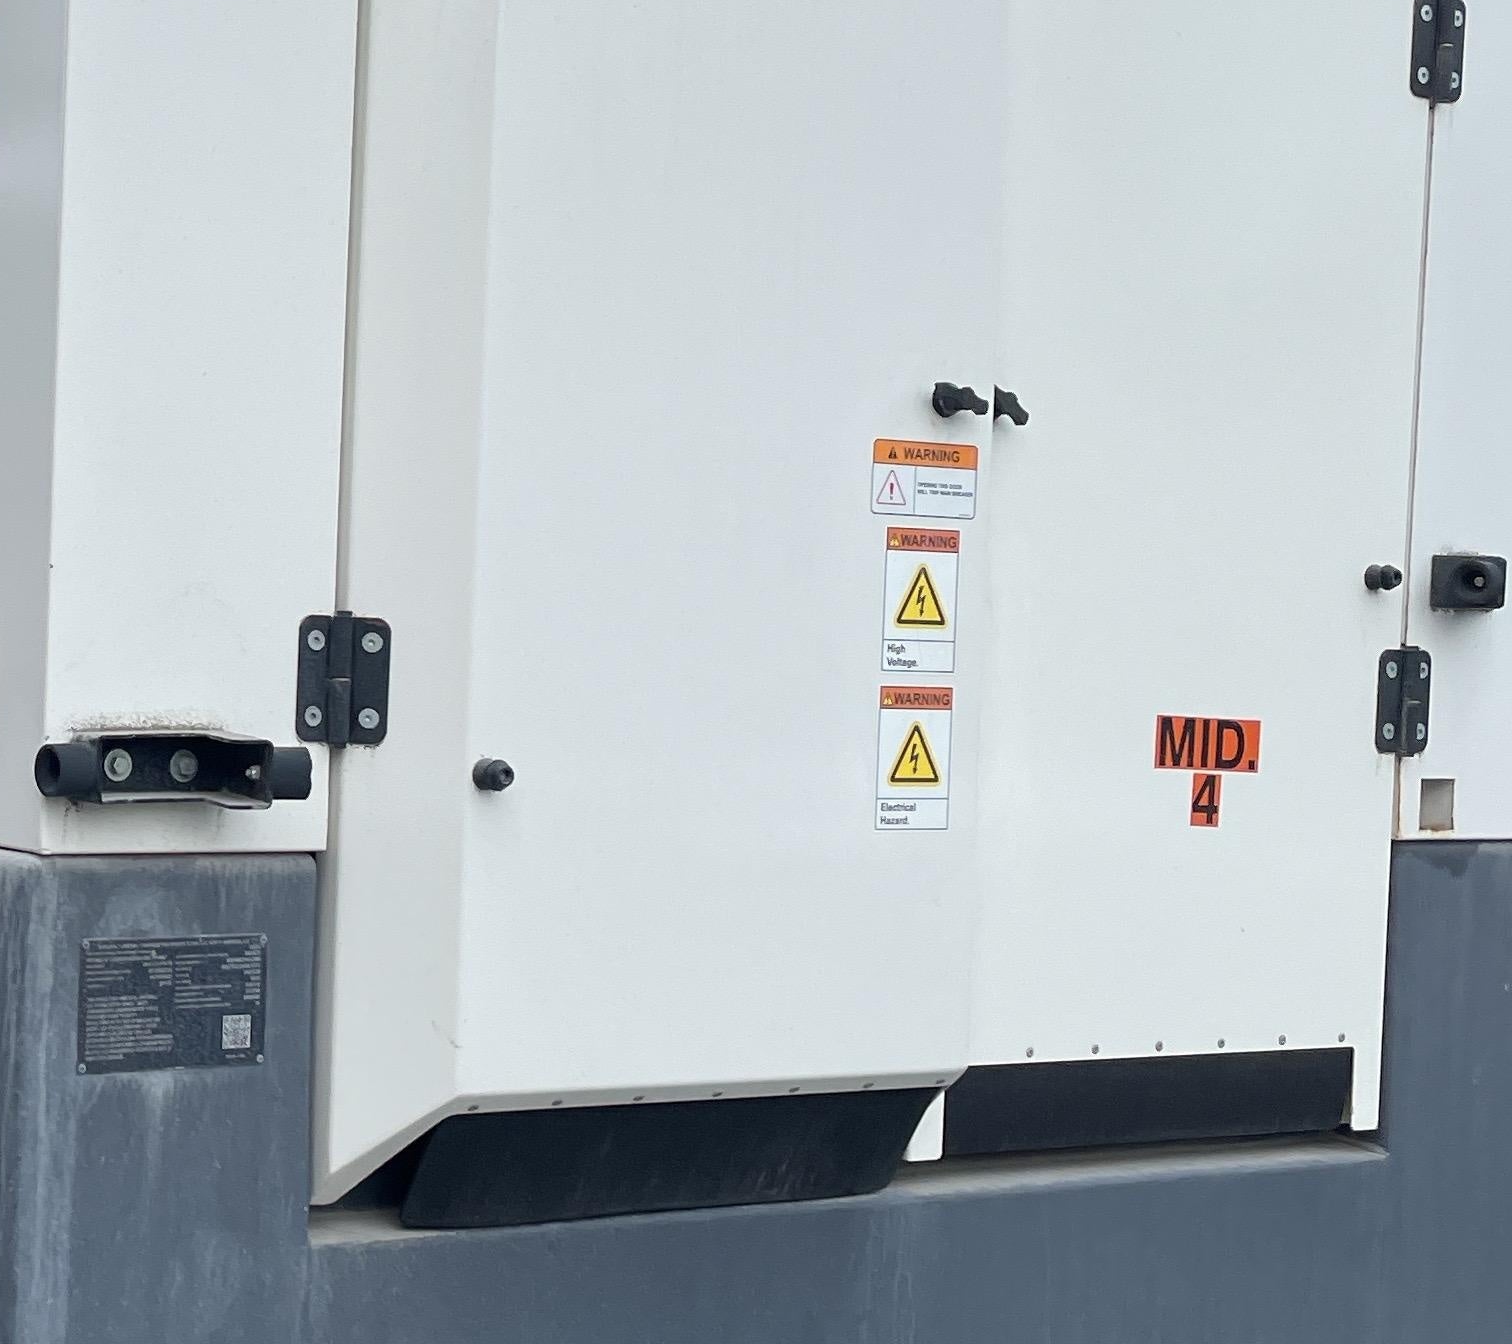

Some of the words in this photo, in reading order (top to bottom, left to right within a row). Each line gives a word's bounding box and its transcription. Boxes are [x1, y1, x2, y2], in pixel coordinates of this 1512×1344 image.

[904, 447, 961, 463] WARNING
[901, 535, 957, 549] WARNING
[887, 644, 906, 655] High
[894, 693, 950, 706] WARNING
[1158, 716, 1256, 770] MID.
[880, 802, 917, 812] Electrical
[1192, 775, 1219, 825] 4
